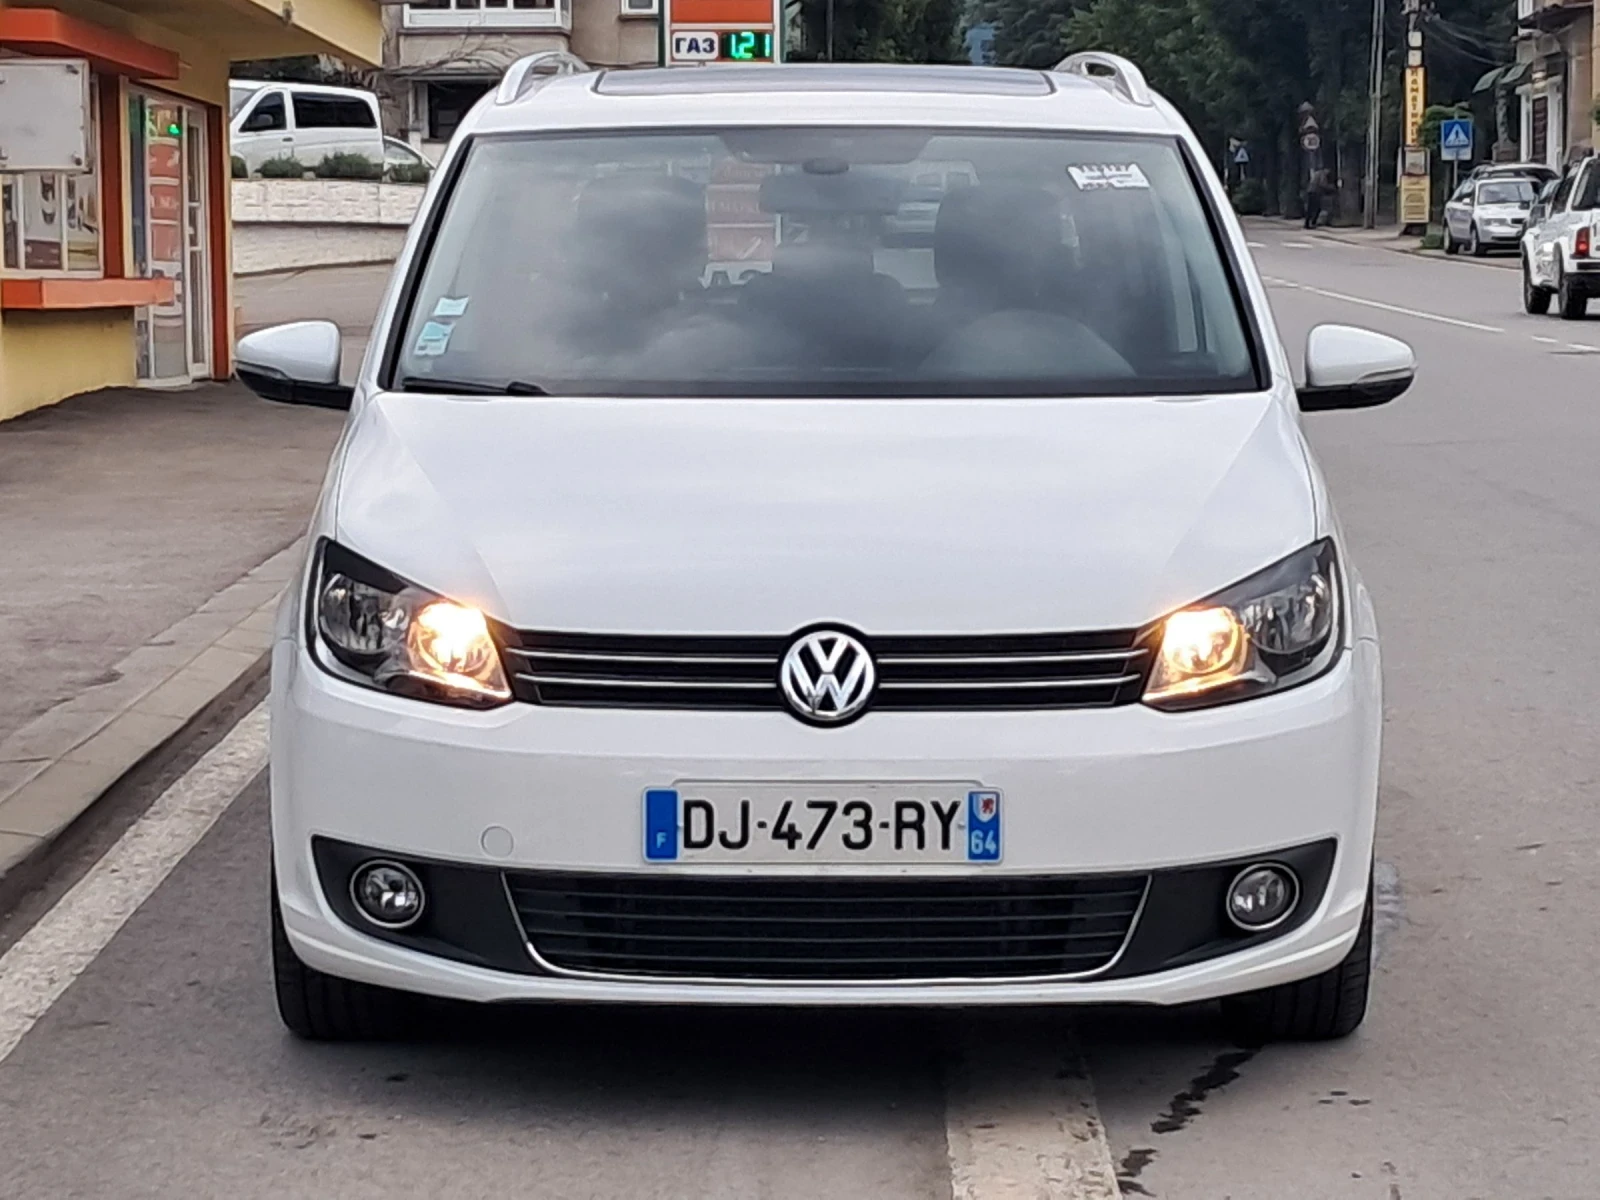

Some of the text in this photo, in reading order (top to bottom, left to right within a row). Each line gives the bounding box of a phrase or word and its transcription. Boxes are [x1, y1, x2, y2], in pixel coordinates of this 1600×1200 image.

[675, 37, 715, 54] ГАЗ
[782, 631, 873, 719] VW
[656, 799, 997, 854] F DJ-473-RY 64
